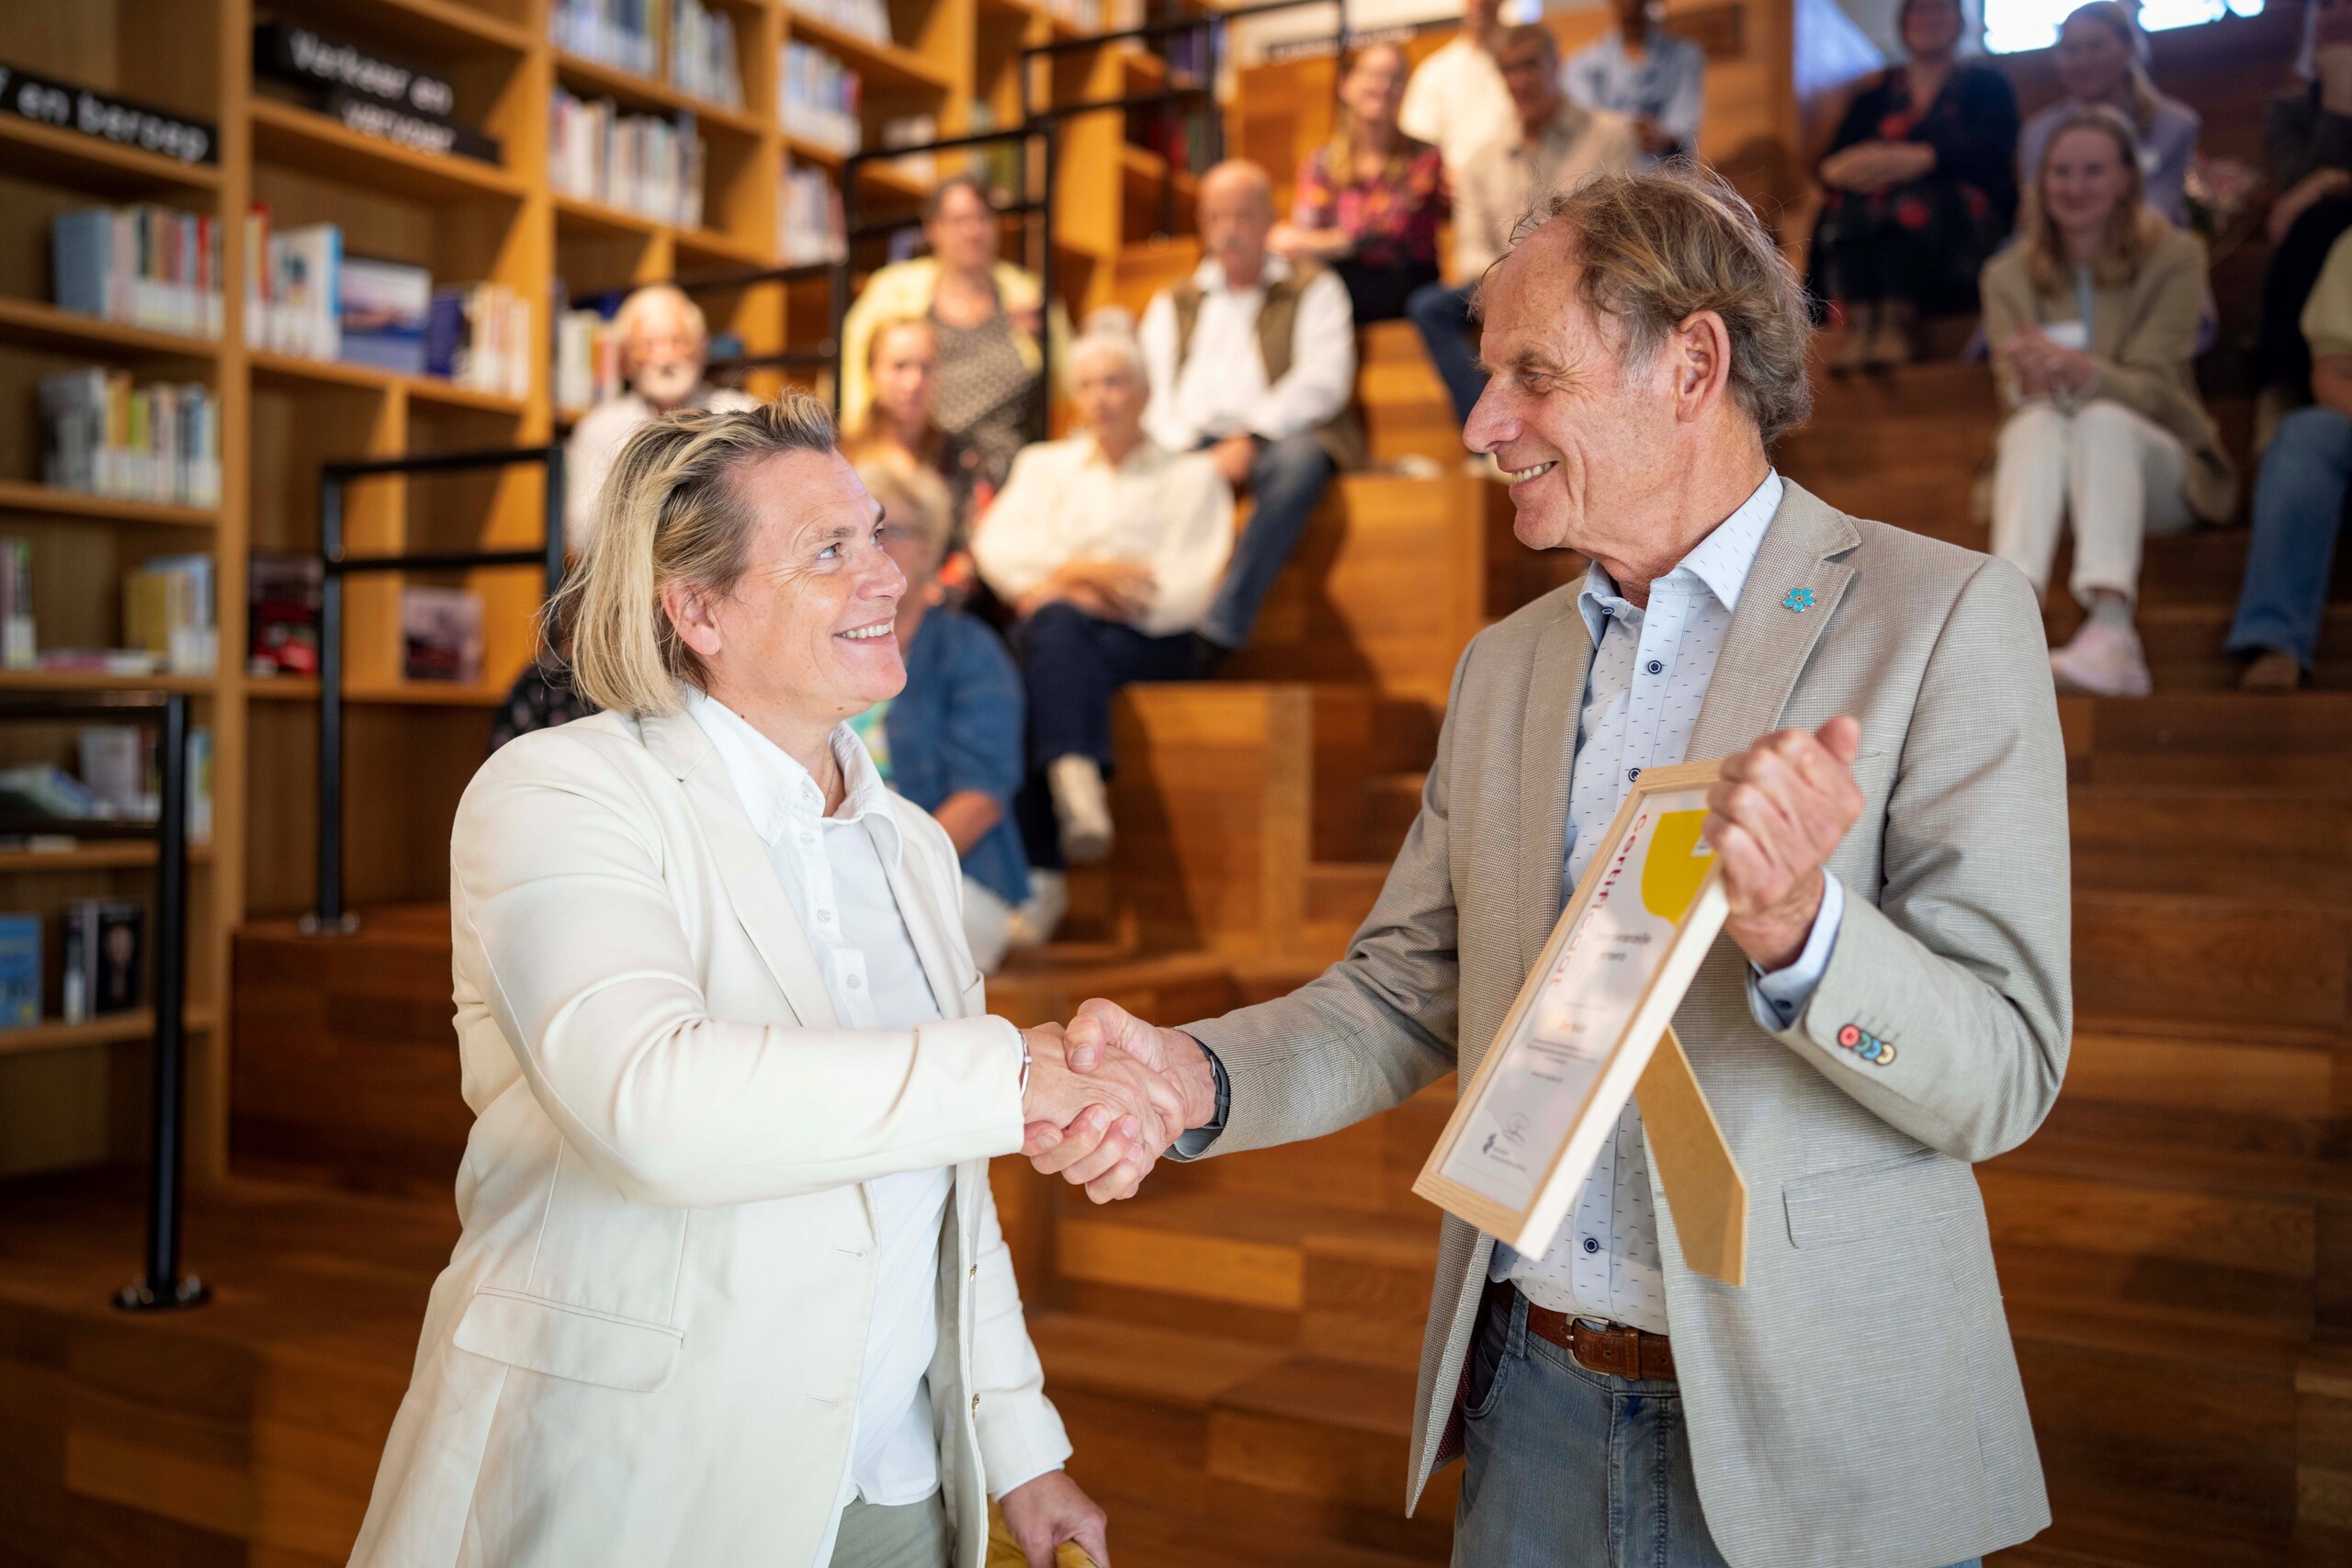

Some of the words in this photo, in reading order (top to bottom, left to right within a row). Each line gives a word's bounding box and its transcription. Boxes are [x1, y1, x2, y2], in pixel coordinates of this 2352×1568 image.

[17, 83, 70, 125] en
[77, 89, 209, 166] beroep
[410, 75, 454, 117] en
